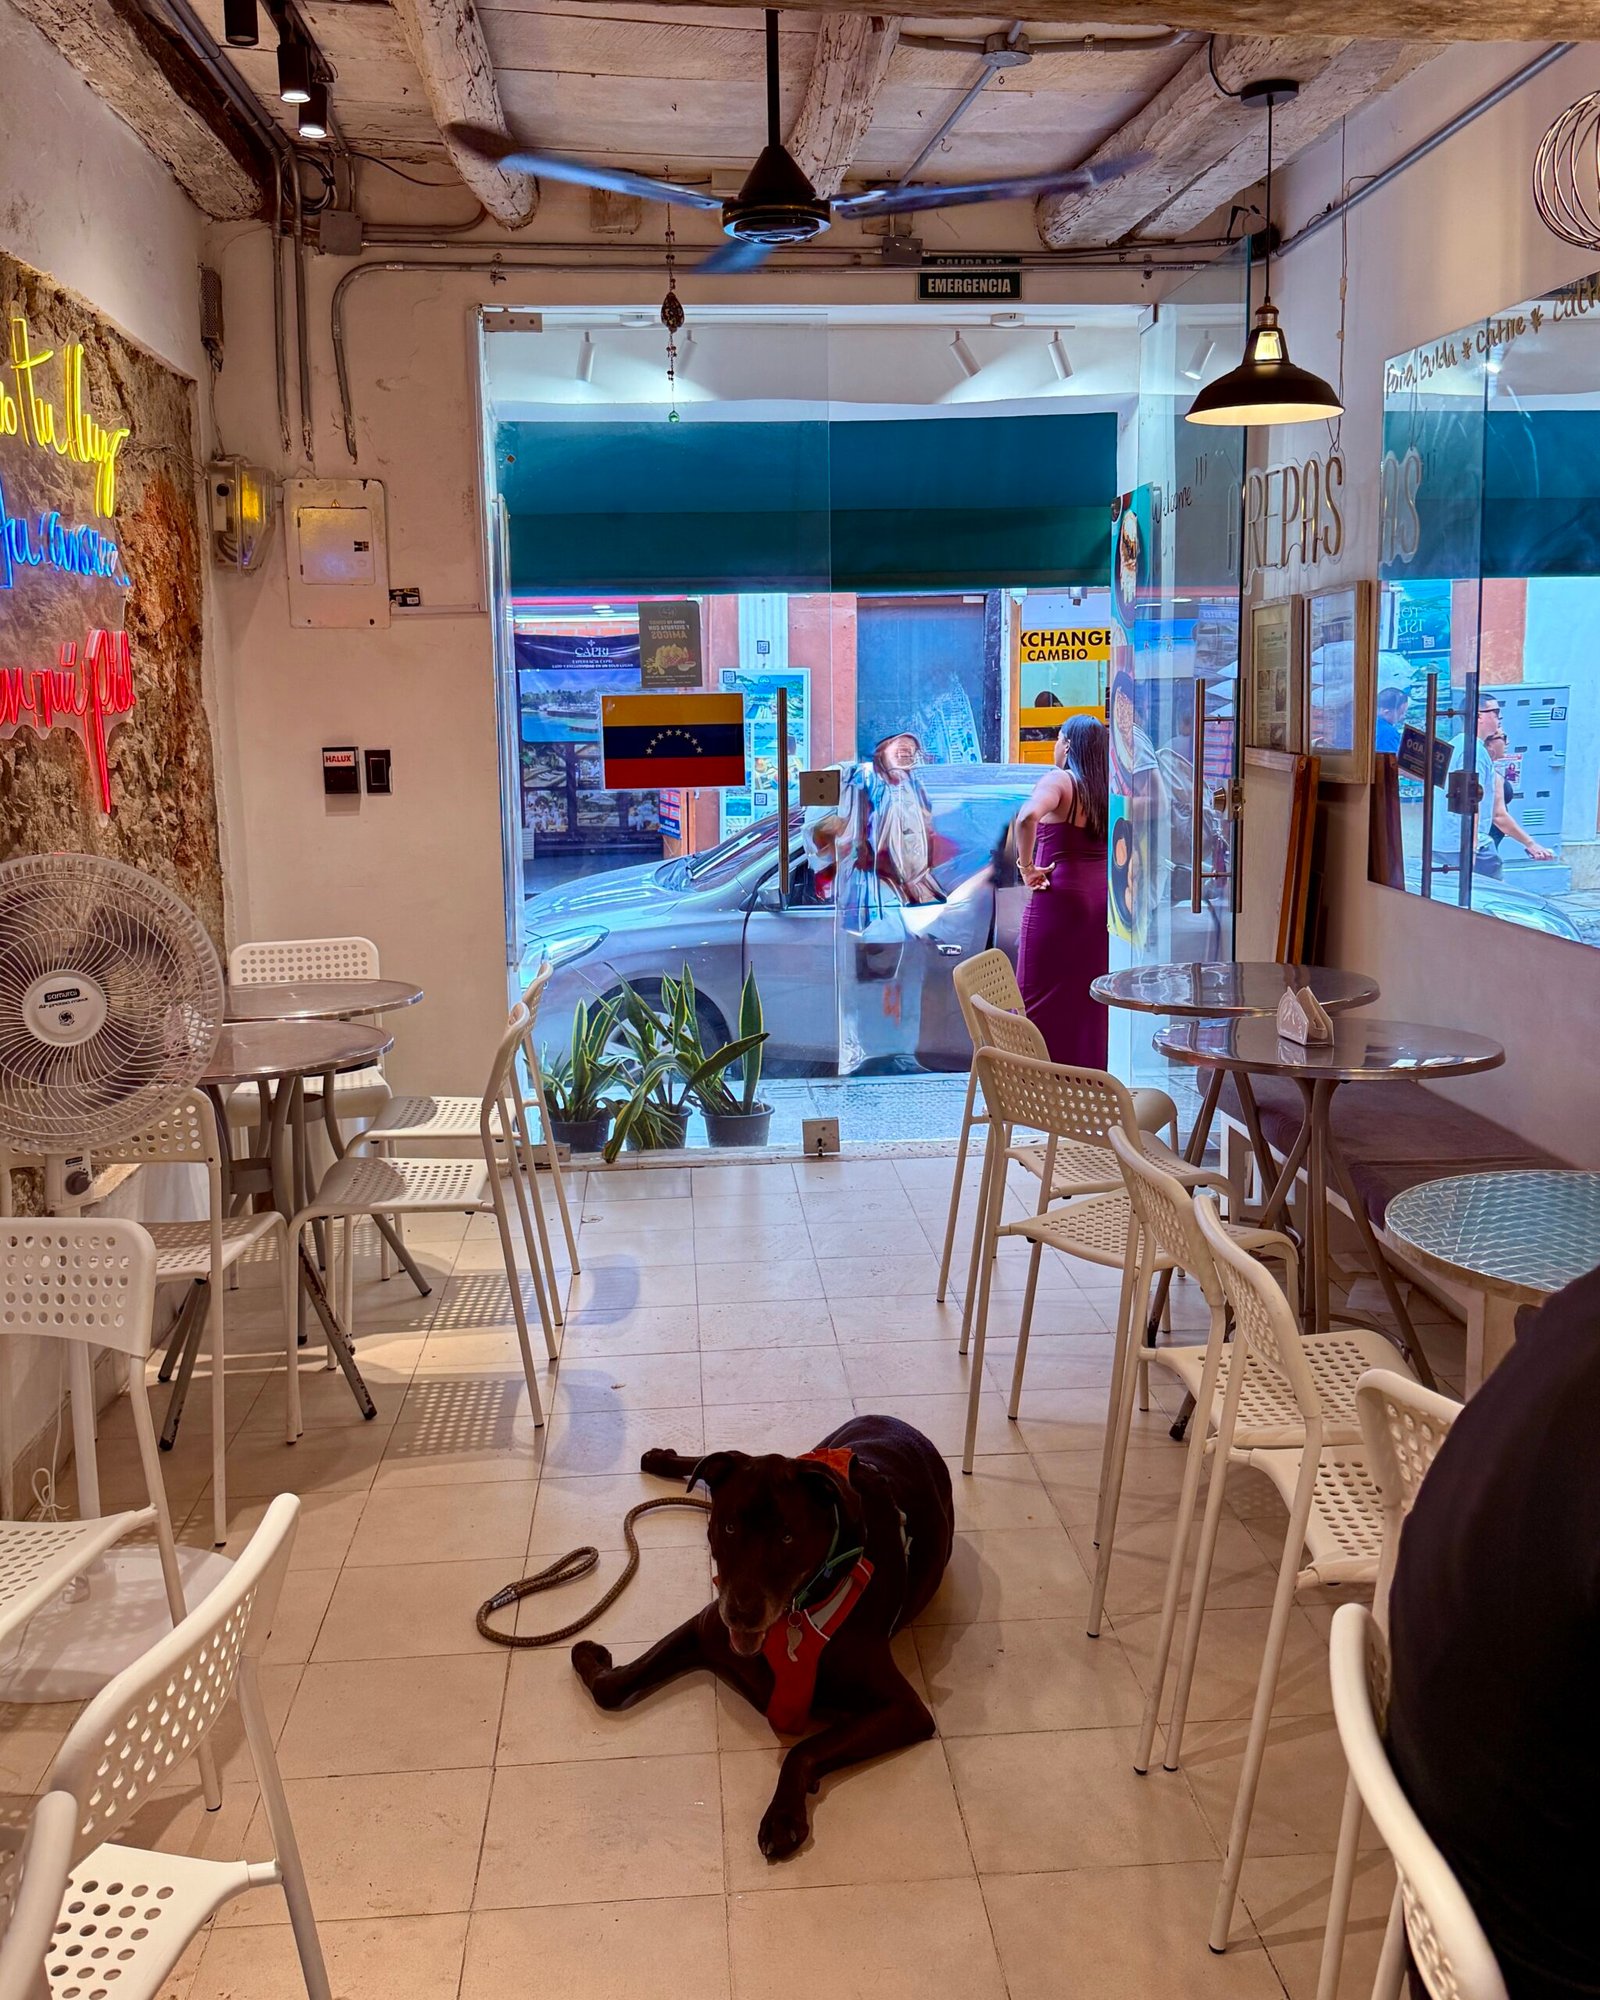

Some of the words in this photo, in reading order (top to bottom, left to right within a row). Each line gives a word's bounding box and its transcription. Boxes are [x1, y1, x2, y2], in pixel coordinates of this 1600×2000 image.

[927, 278, 1012, 293] EMERGENCIA
[1227, 456, 1343, 570] AREPAS
[574, 647, 609, 657] CAPRI
[1027, 648, 1088, 661] CAMBIO
[325, 754, 352, 763] HALUX
